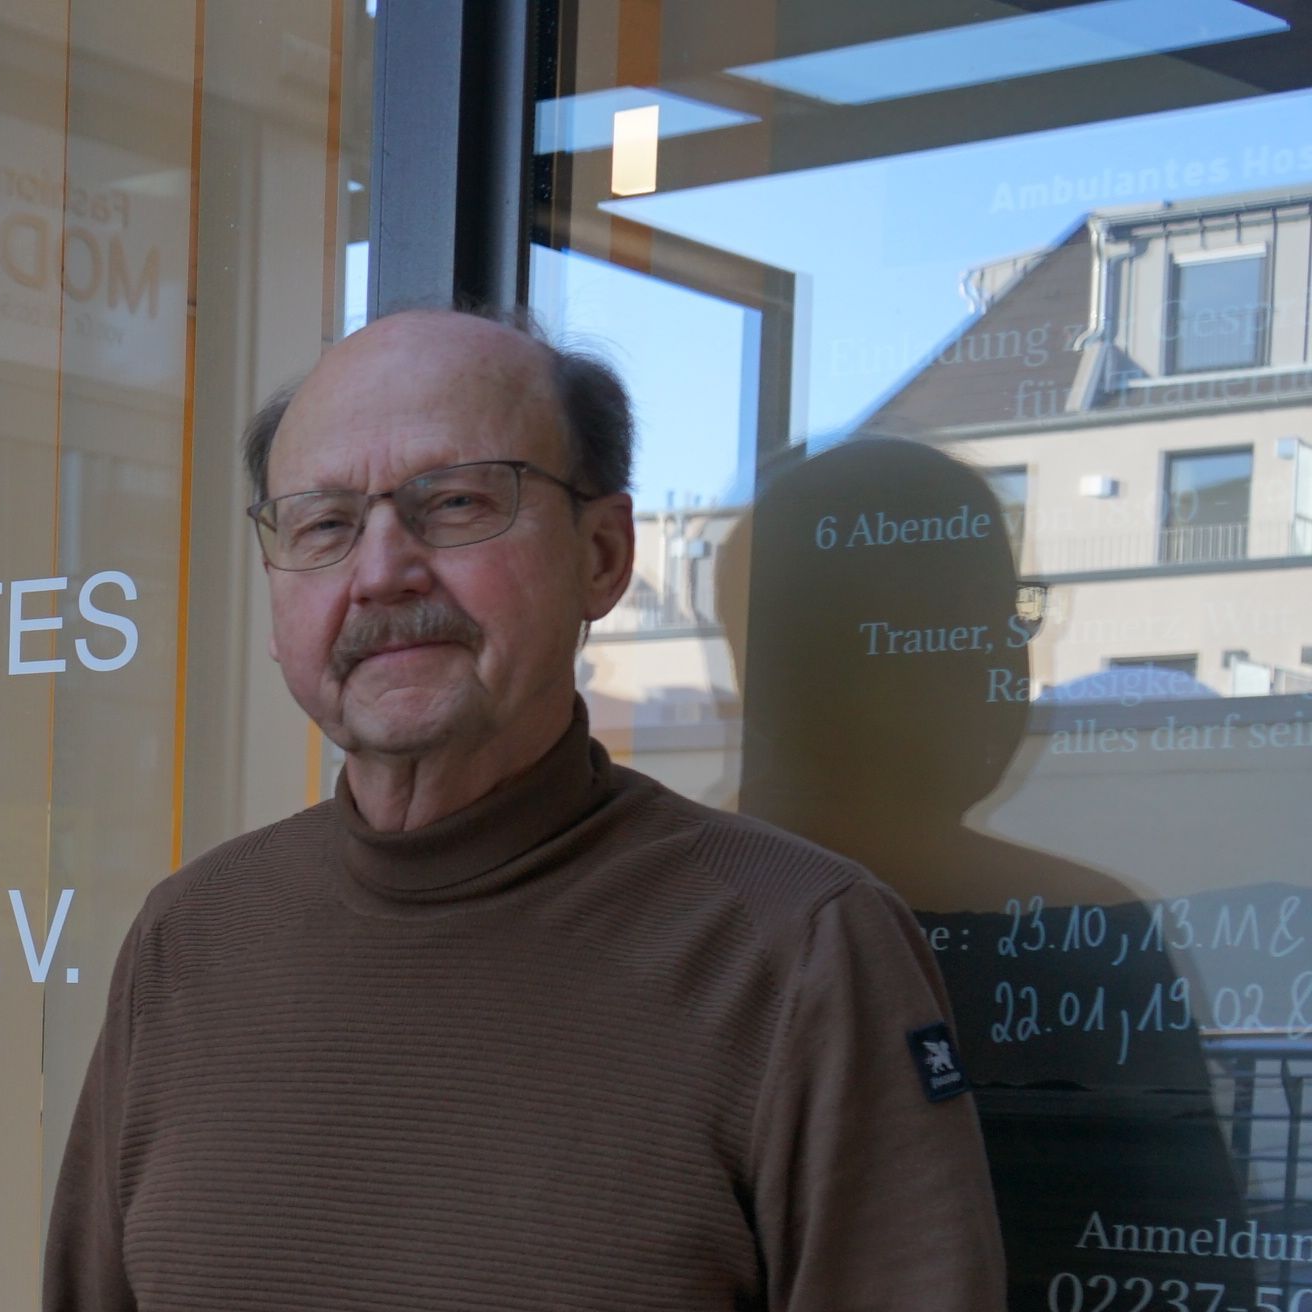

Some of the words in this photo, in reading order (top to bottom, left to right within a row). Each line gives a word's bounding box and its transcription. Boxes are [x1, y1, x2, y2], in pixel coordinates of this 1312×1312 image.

[989, 156, 1231, 214] Ambulantes
[815, 516, 838, 549] 6
[845, 505, 992, 547] Abende
[860, 619, 994, 655] Trauer,
[1050, 719, 1136, 755] alles
[1151, 713, 1241, 751] darf
[1247, 710, 1312, 748] sei
